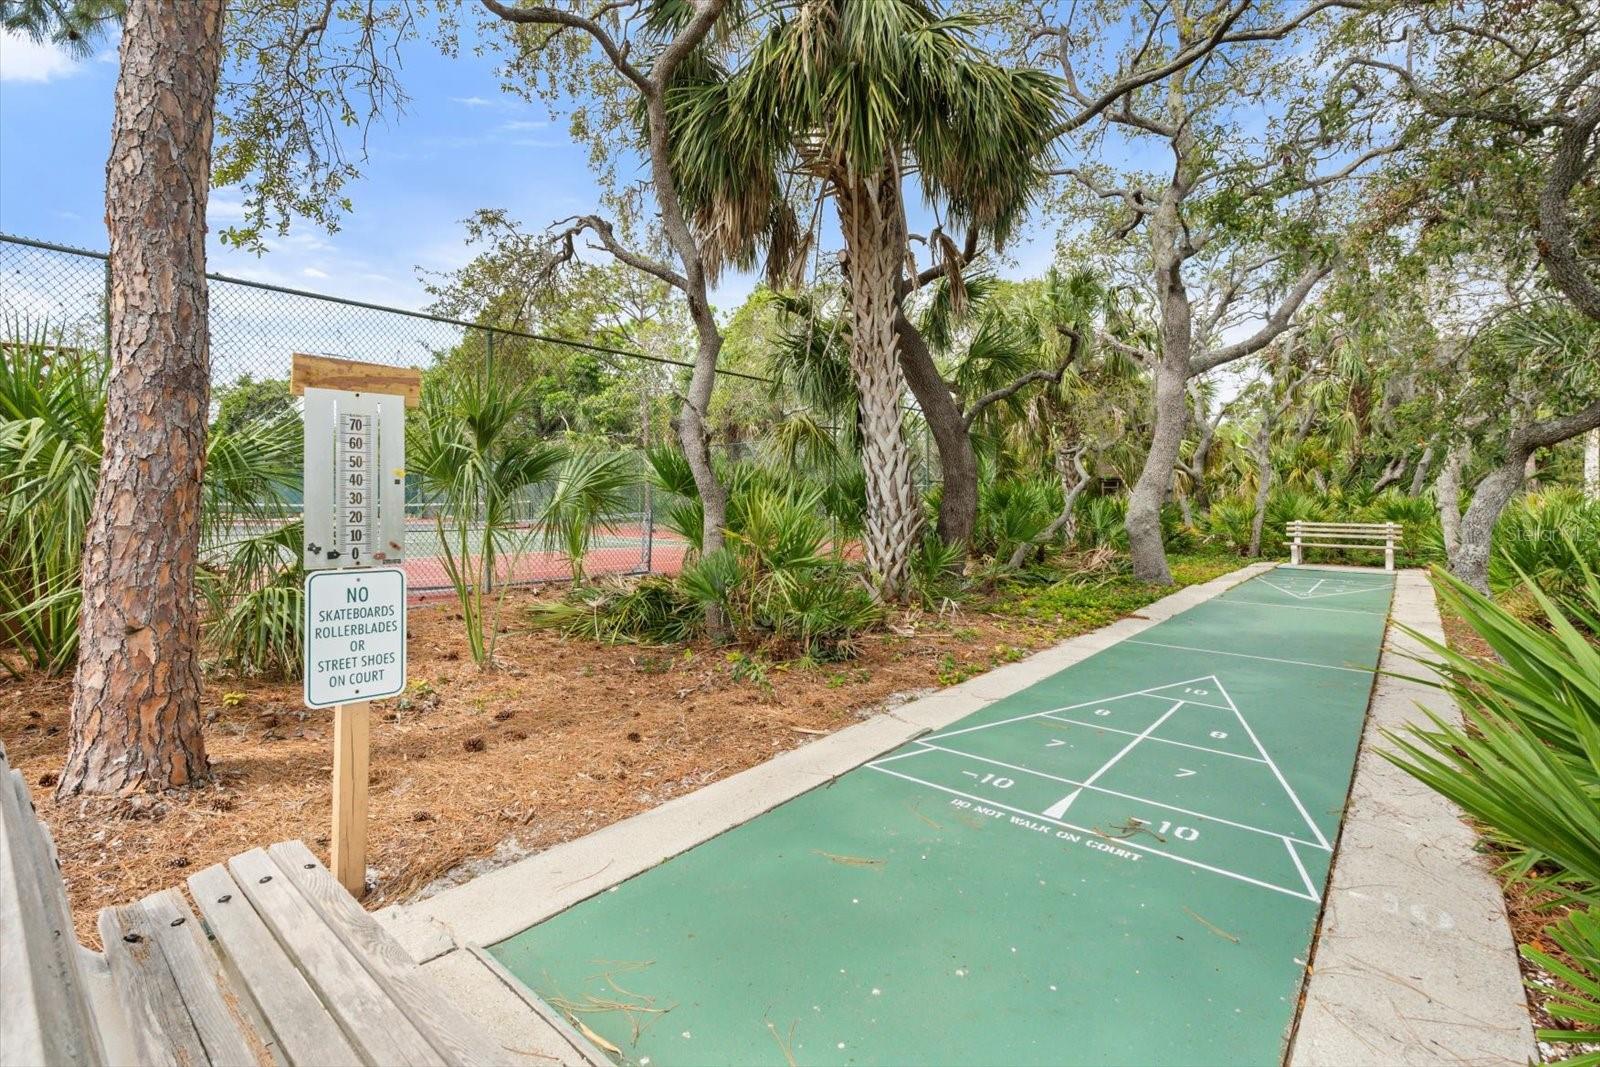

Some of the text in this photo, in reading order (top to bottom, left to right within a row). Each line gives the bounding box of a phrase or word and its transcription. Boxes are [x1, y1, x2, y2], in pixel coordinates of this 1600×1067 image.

[349, 419, 363, 431] 70
[349, 437, 363, 449] 60
[349, 456, 363, 468] 50
[349, 474, 363, 486] 40
[349, 492, 363, 504] 30
[349, 511, 363, 523] 20
[350, 529, 362, 542] 10
[351, 548, 359, 560] 0
[346, 586, 369, 603] NO
[319, 605, 395, 622] SKATEBOARDS
[315, 620, 398, 639] ROLLERBLADES
[350, 640, 365, 652] OR
[318, 652, 395, 673] STREET SHOES
[329, 669, 385, 688] ON COURT
[1184, 687, 1208, 696] 10
[962, 770, 1015, 789] -10
[951, 798, 1143, 861] DO NOT WALK ON COURT
